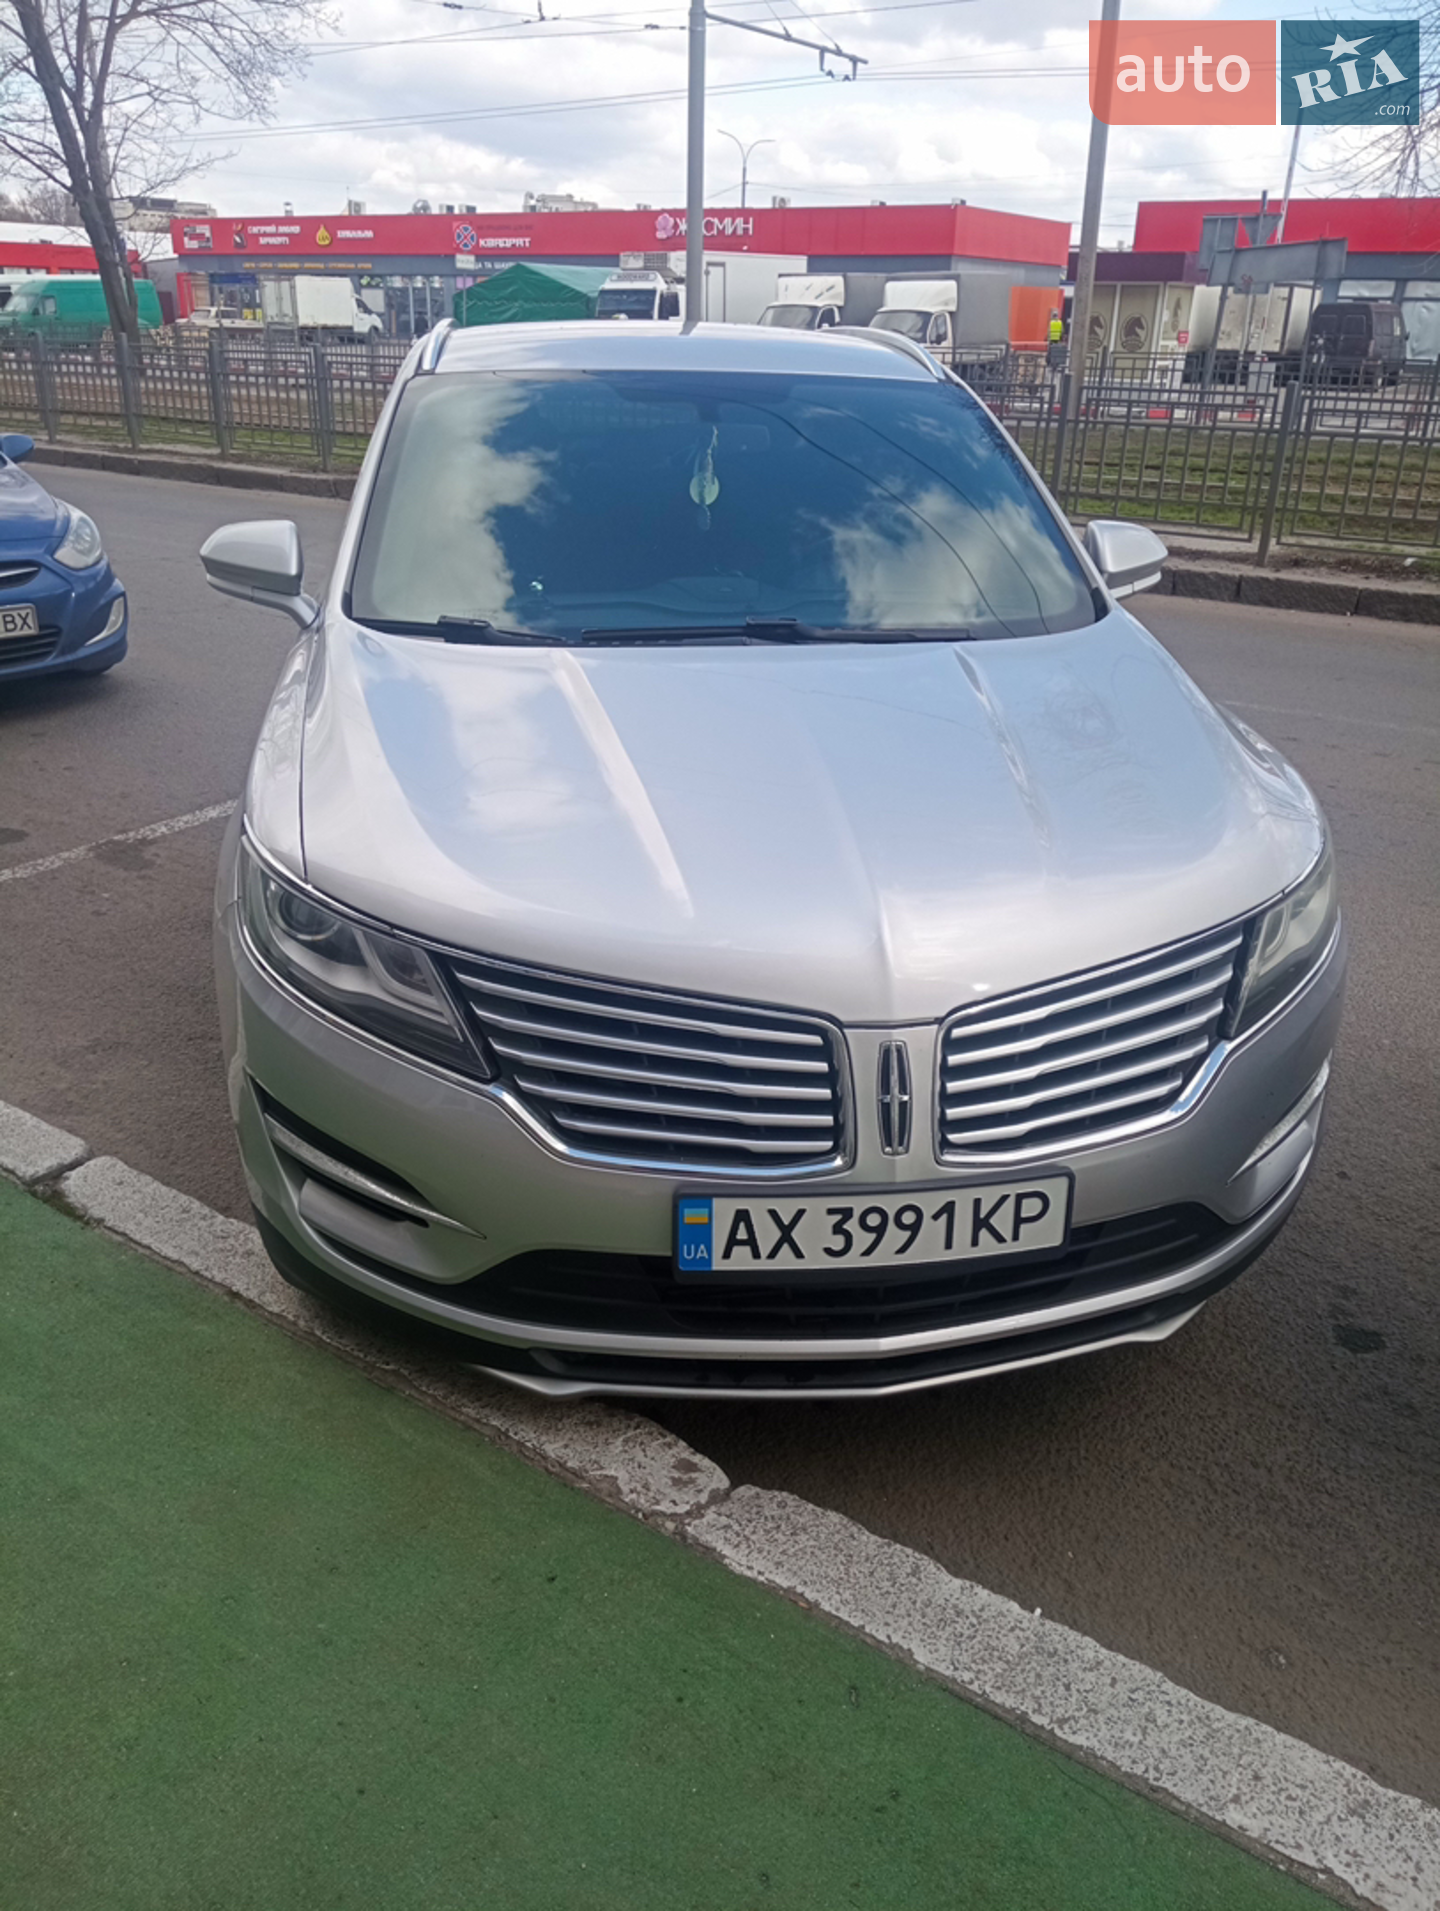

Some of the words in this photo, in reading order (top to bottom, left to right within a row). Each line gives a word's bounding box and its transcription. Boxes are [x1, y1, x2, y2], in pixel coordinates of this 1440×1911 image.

[676, 217, 753, 236] ЖСМИН
[721, 1207, 806, 1261] AX
[822, 1199, 956, 1258] 3991
[970, 1189, 1050, 1247] KP
[683, 1244, 708, 1260] UA
